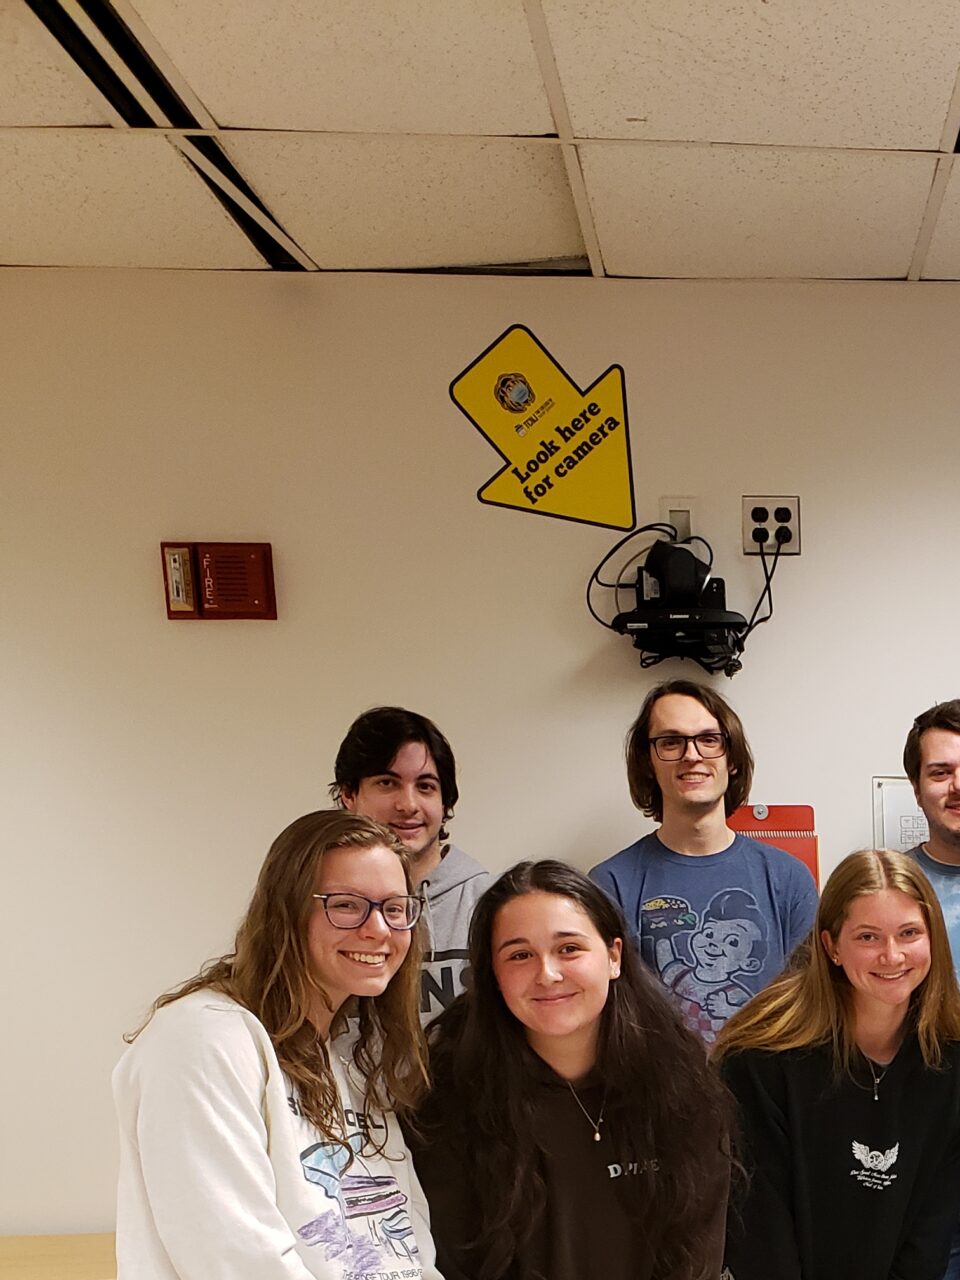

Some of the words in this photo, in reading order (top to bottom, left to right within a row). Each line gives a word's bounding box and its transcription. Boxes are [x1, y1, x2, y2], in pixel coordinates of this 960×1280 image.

[511, 439, 561, 485] Look
[554, 400, 601, 444] here
[523, 479, 555, 505] for
[553, 416, 621, 479] camera
[203, 558, 214, 599] FIRE
